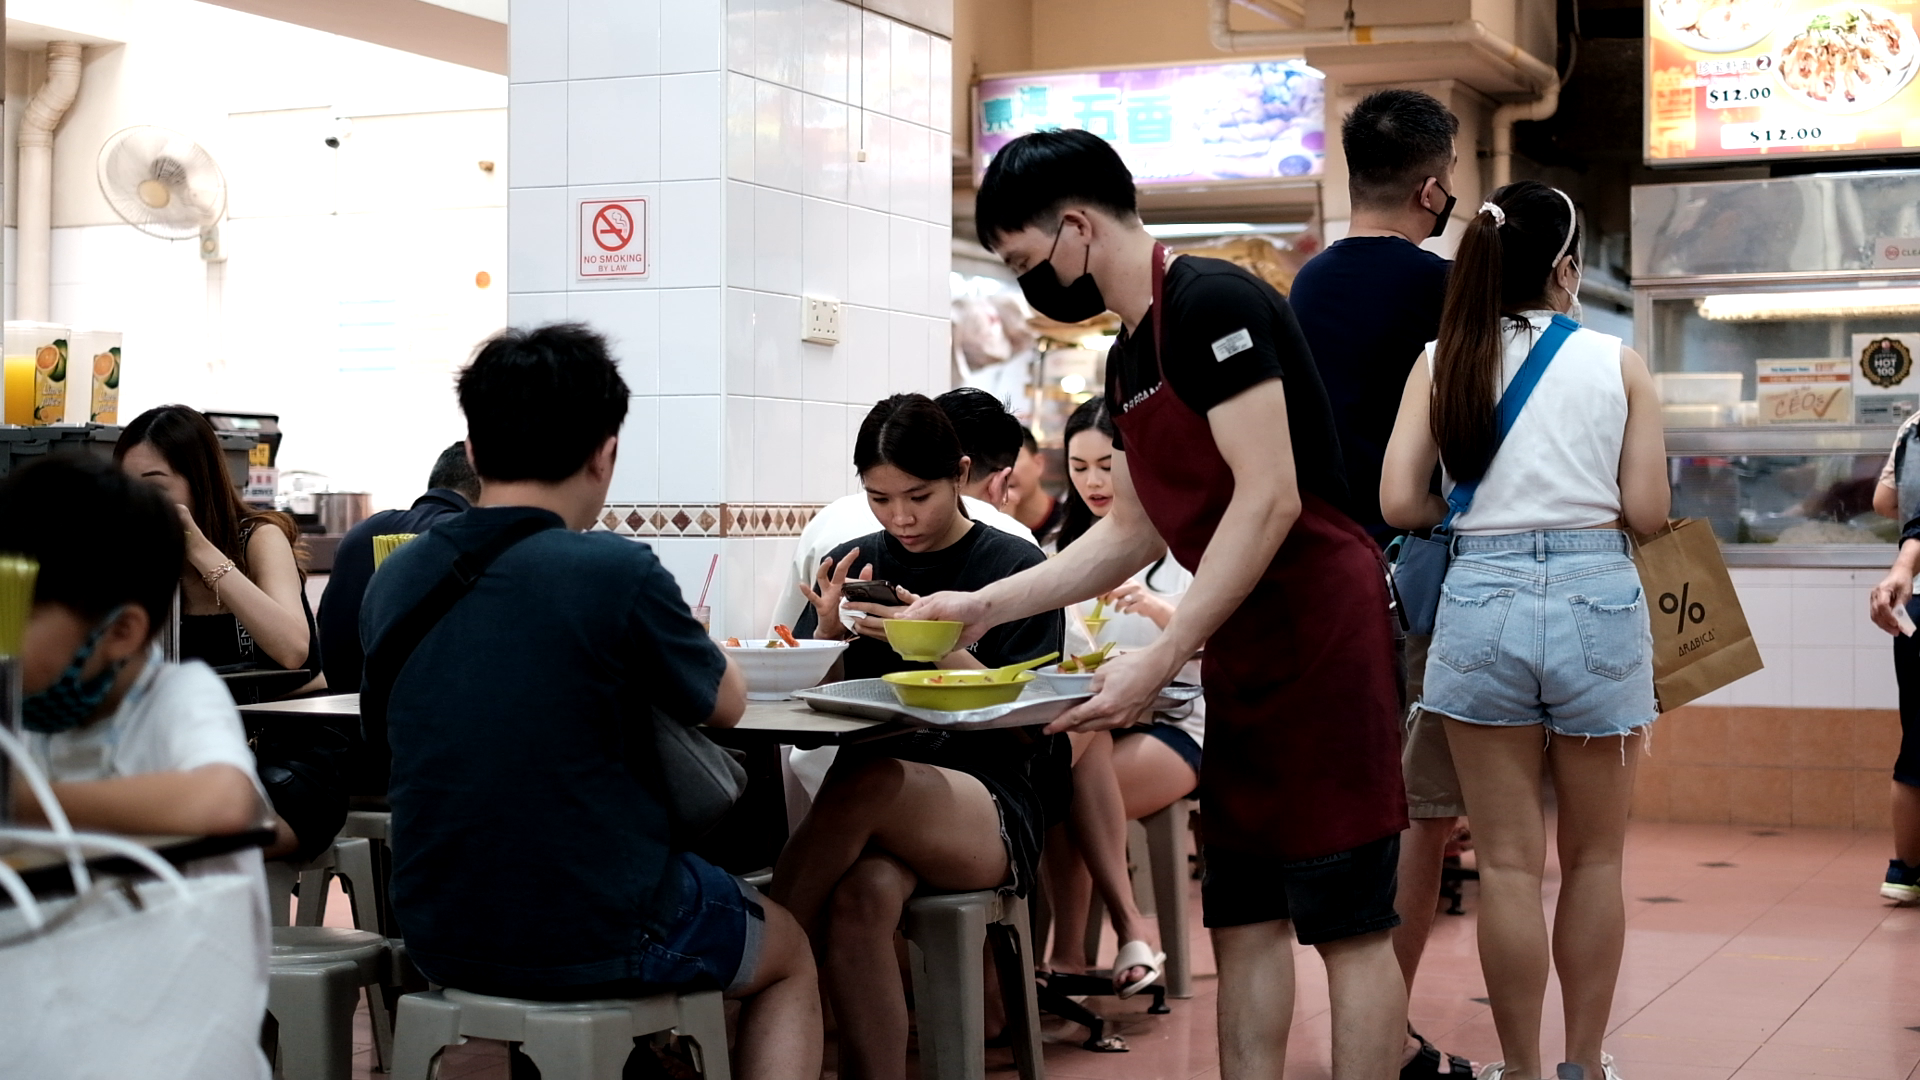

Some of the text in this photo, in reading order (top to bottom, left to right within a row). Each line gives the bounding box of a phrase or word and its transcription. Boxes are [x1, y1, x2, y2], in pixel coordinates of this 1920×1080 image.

[1709, 87, 1771, 103] $12.00
[1750, 127, 1822, 143] $12.00
[584, 254, 642, 264] NO SMOKING
[1901, 249, 1920, 257] CLE
[1874, 358, 1897, 368] HOT
[1877, 367, 1895, 377] 100
[1658, 581, 1706, 635] %
[1678, 630, 1715, 657] ARABICA
